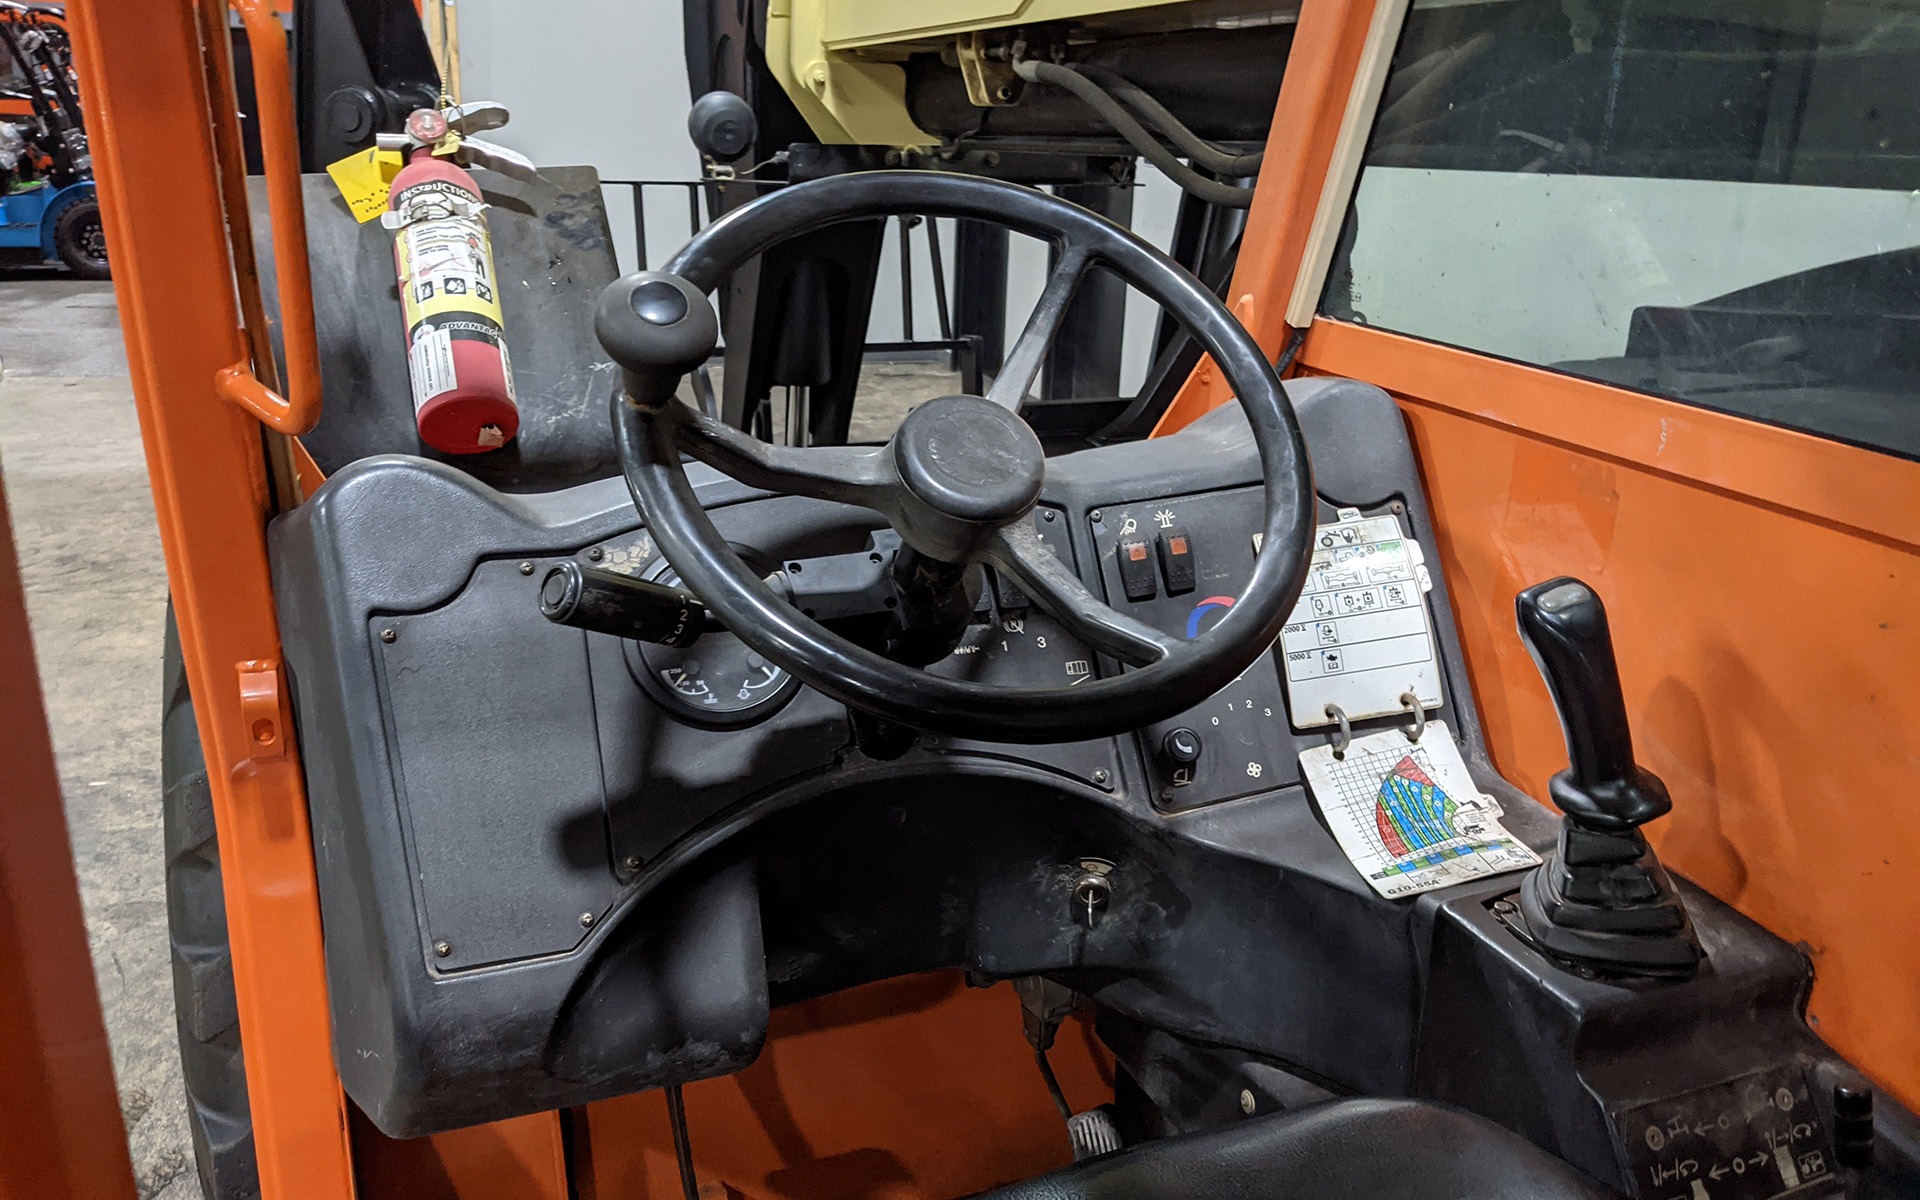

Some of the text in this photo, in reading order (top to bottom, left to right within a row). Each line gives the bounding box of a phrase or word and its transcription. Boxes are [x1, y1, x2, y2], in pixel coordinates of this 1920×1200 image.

[680, 609, 689, 621] 2
[674, 624, 684, 635] 3
[1284, 625, 1300, 634] 2000
[1001, 640, 1008, 651] 1
[1037, 636, 1047, 648] 3
[1289, 653, 1306, 661] 5000
[1211, 699, 1272, 726] 0 1 2 3
